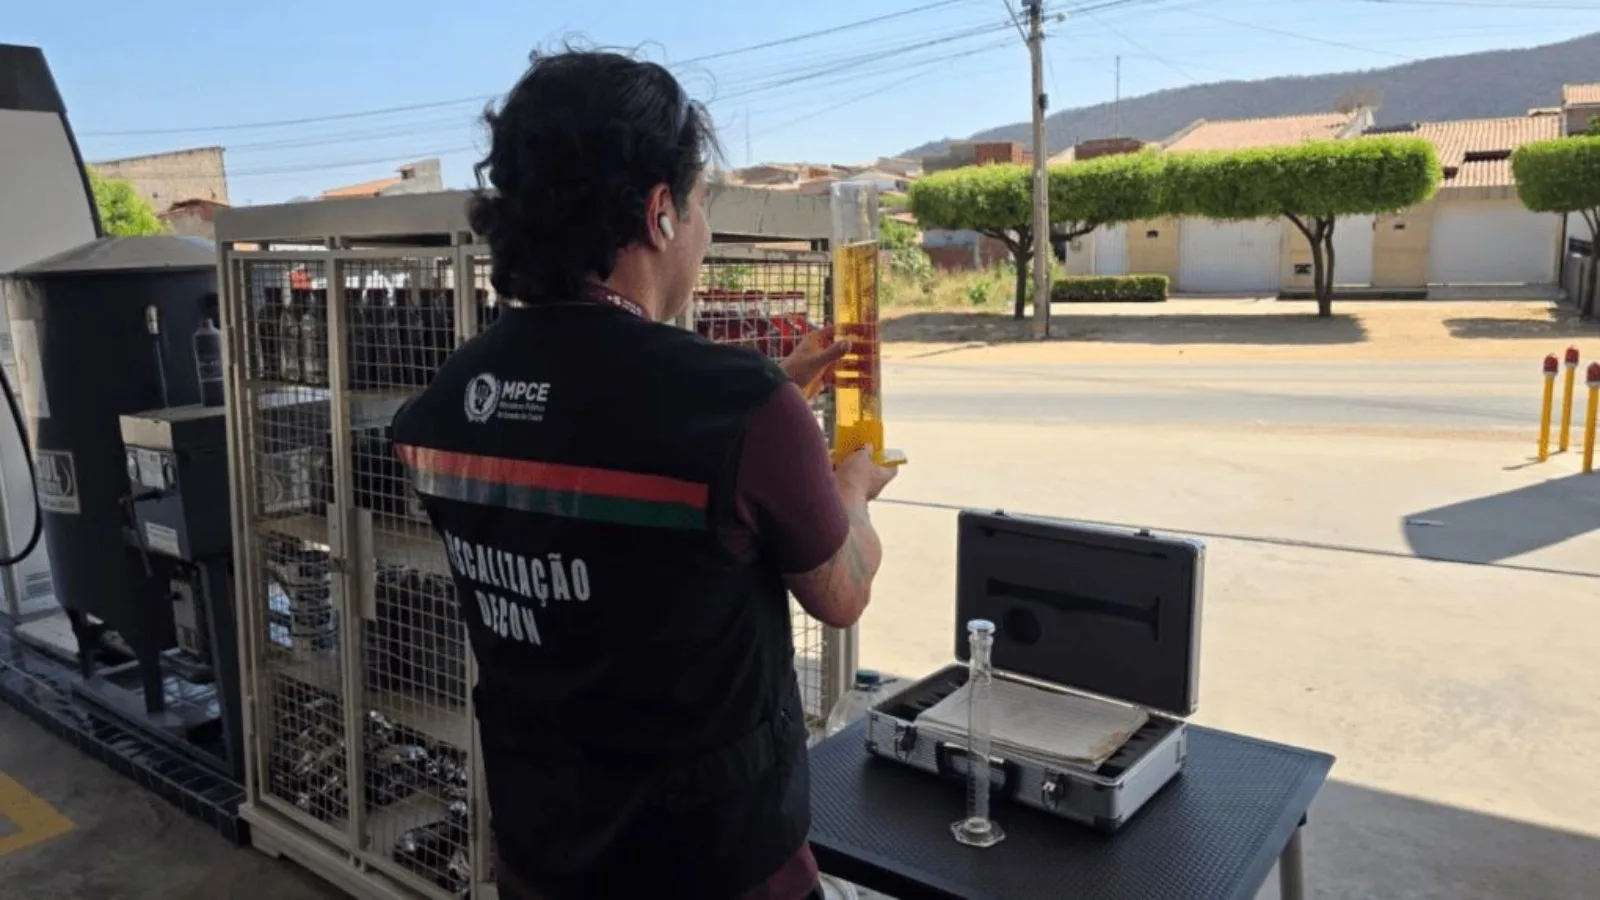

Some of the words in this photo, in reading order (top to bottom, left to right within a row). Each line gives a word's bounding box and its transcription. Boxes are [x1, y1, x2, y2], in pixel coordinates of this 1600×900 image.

[501, 381, 551, 402] MPCE
[445, 529, 591, 607] ISCALIZAÇÃO
[474, 589, 542, 646] DECON
